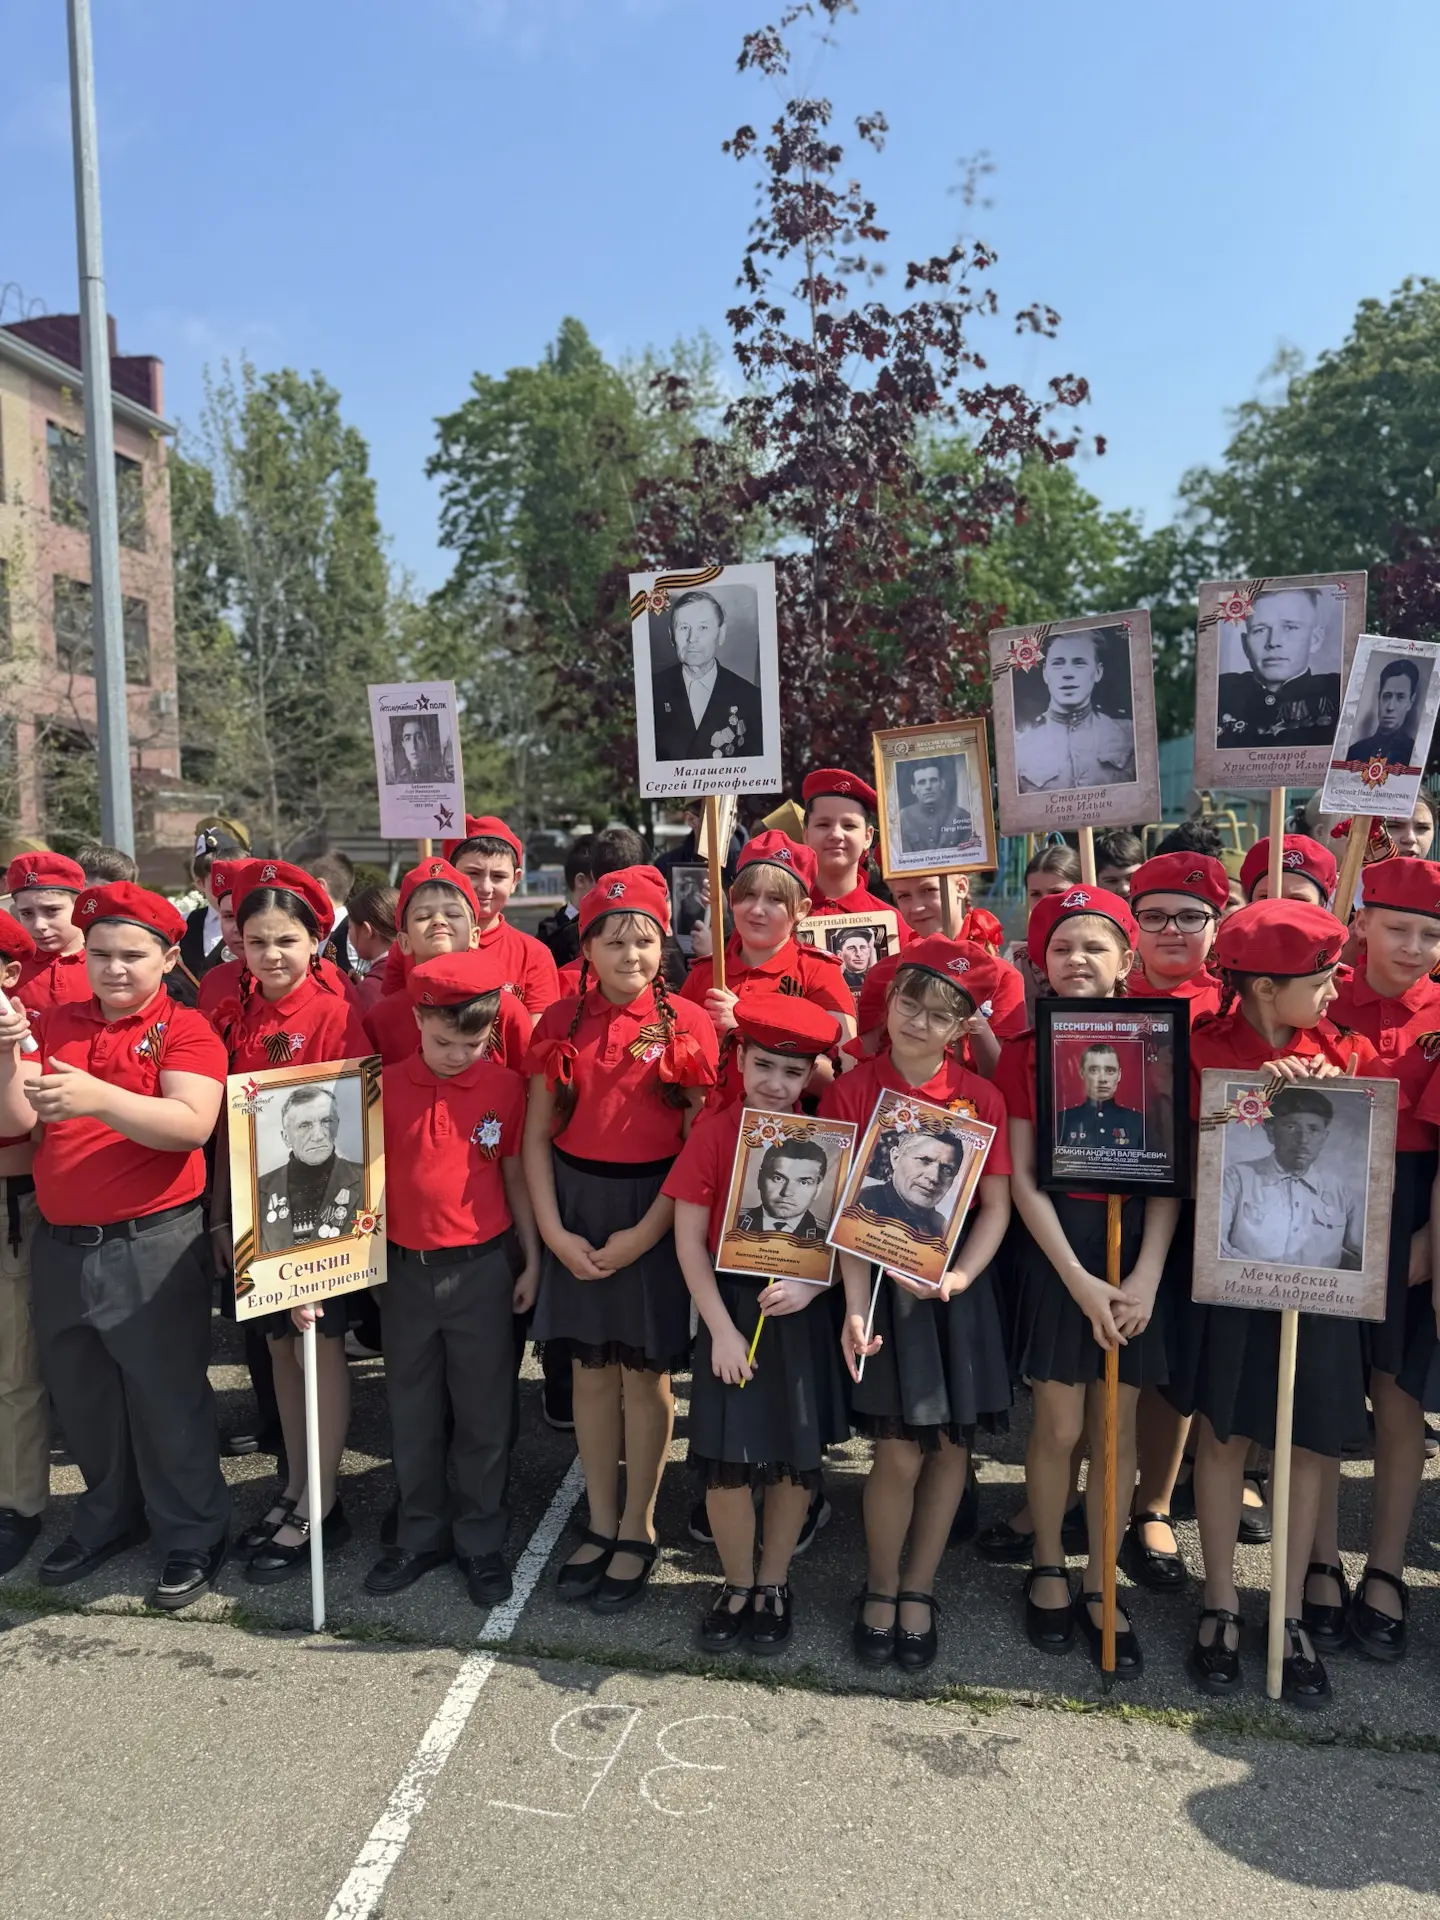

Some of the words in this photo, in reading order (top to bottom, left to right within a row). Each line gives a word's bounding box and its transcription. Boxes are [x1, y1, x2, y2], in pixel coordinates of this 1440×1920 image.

[1249, 749, 1307, 761] Столяров
[673, 765, 747, 777] Малашенко
[1222, 760, 1291, 774] Христофор
[645, 780, 688, 793] Сергей
[692, 777, 777, 791] Прокофьевич
[1050, 788, 1107, 804] Столяров
[1045, 804, 1073, 814] Илья
[1077, 800, 1112, 811] Ильич
[800, 917, 848, 928] СМЕРТНЫЙ
[849, 916, 873, 924] ПОЛК
[1053, 1021, 1114, 1032] БЕССМЕРТНЫЙ
[1115, 1022, 1138, 1032] ПОЛК
[1152, 1023, 1169, 1032] СВО
[955, 1132, 976, 1143] ПОЛК
[1054, 1147, 1085, 1156] ТОМКИН
[1085, 1148, 1117, 1158] АНДРЕЙ
[1117, 1150, 1167, 1159] ВАЛЕРЬЕВИЧ
[882, 1239, 918, 1256] Дмитриевич
[278, 1253, 350, 1280] Сечкин
[764, 1255, 800, 1264] Григорьевич
[1240, 1267, 1339, 1288] Мечковский
[247, 1291, 283, 1308] Егор
[287, 1267, 378, 1300] Дмитриевич
[1224, 1280, 1262, 1295] Илья
[1268, 1285, 1356, 1305] Андреевич
